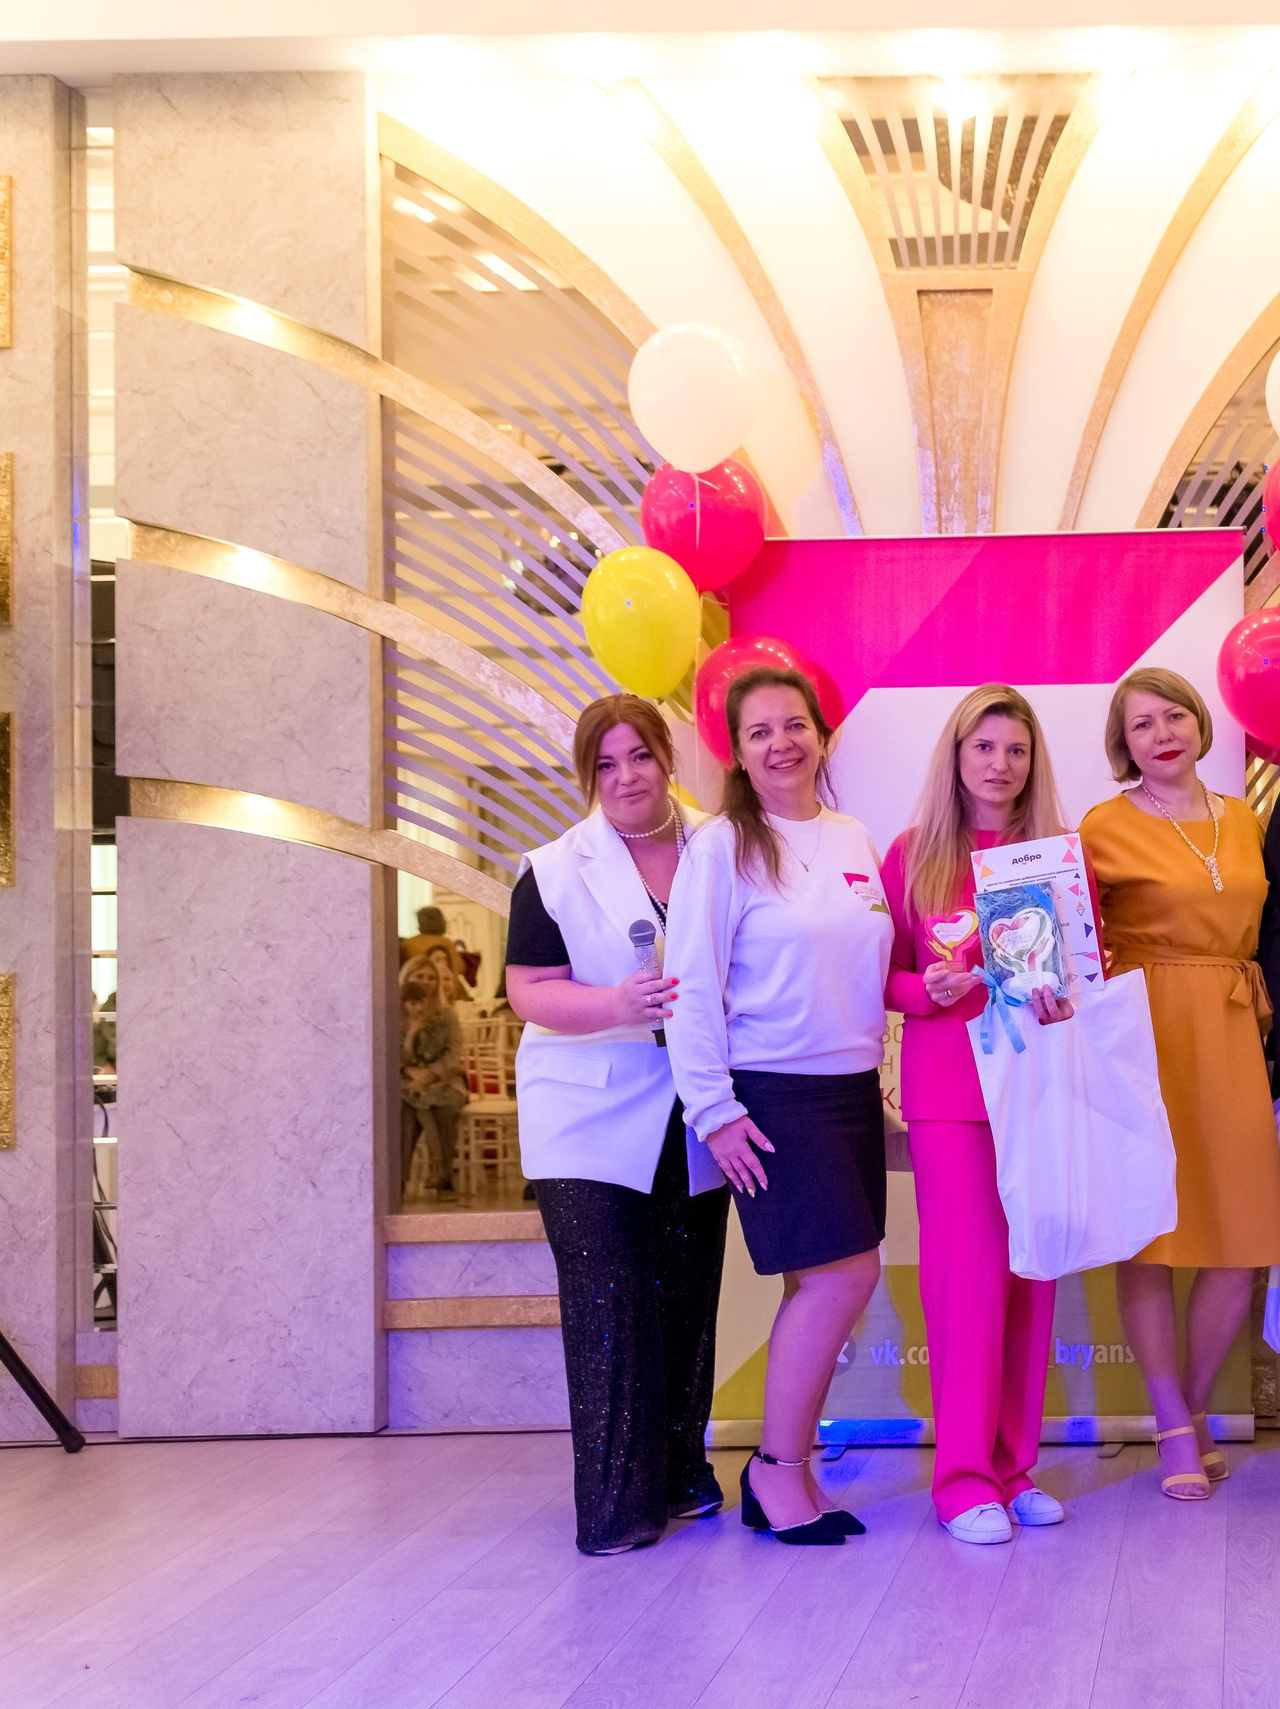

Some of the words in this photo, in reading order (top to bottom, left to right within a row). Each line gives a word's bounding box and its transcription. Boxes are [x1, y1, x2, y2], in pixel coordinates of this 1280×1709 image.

[1012, 853, 1042, 865] добро
[870, 1338, 929, 1366] vk.co
[1047, 1337, 1135, 1370] _bryans
